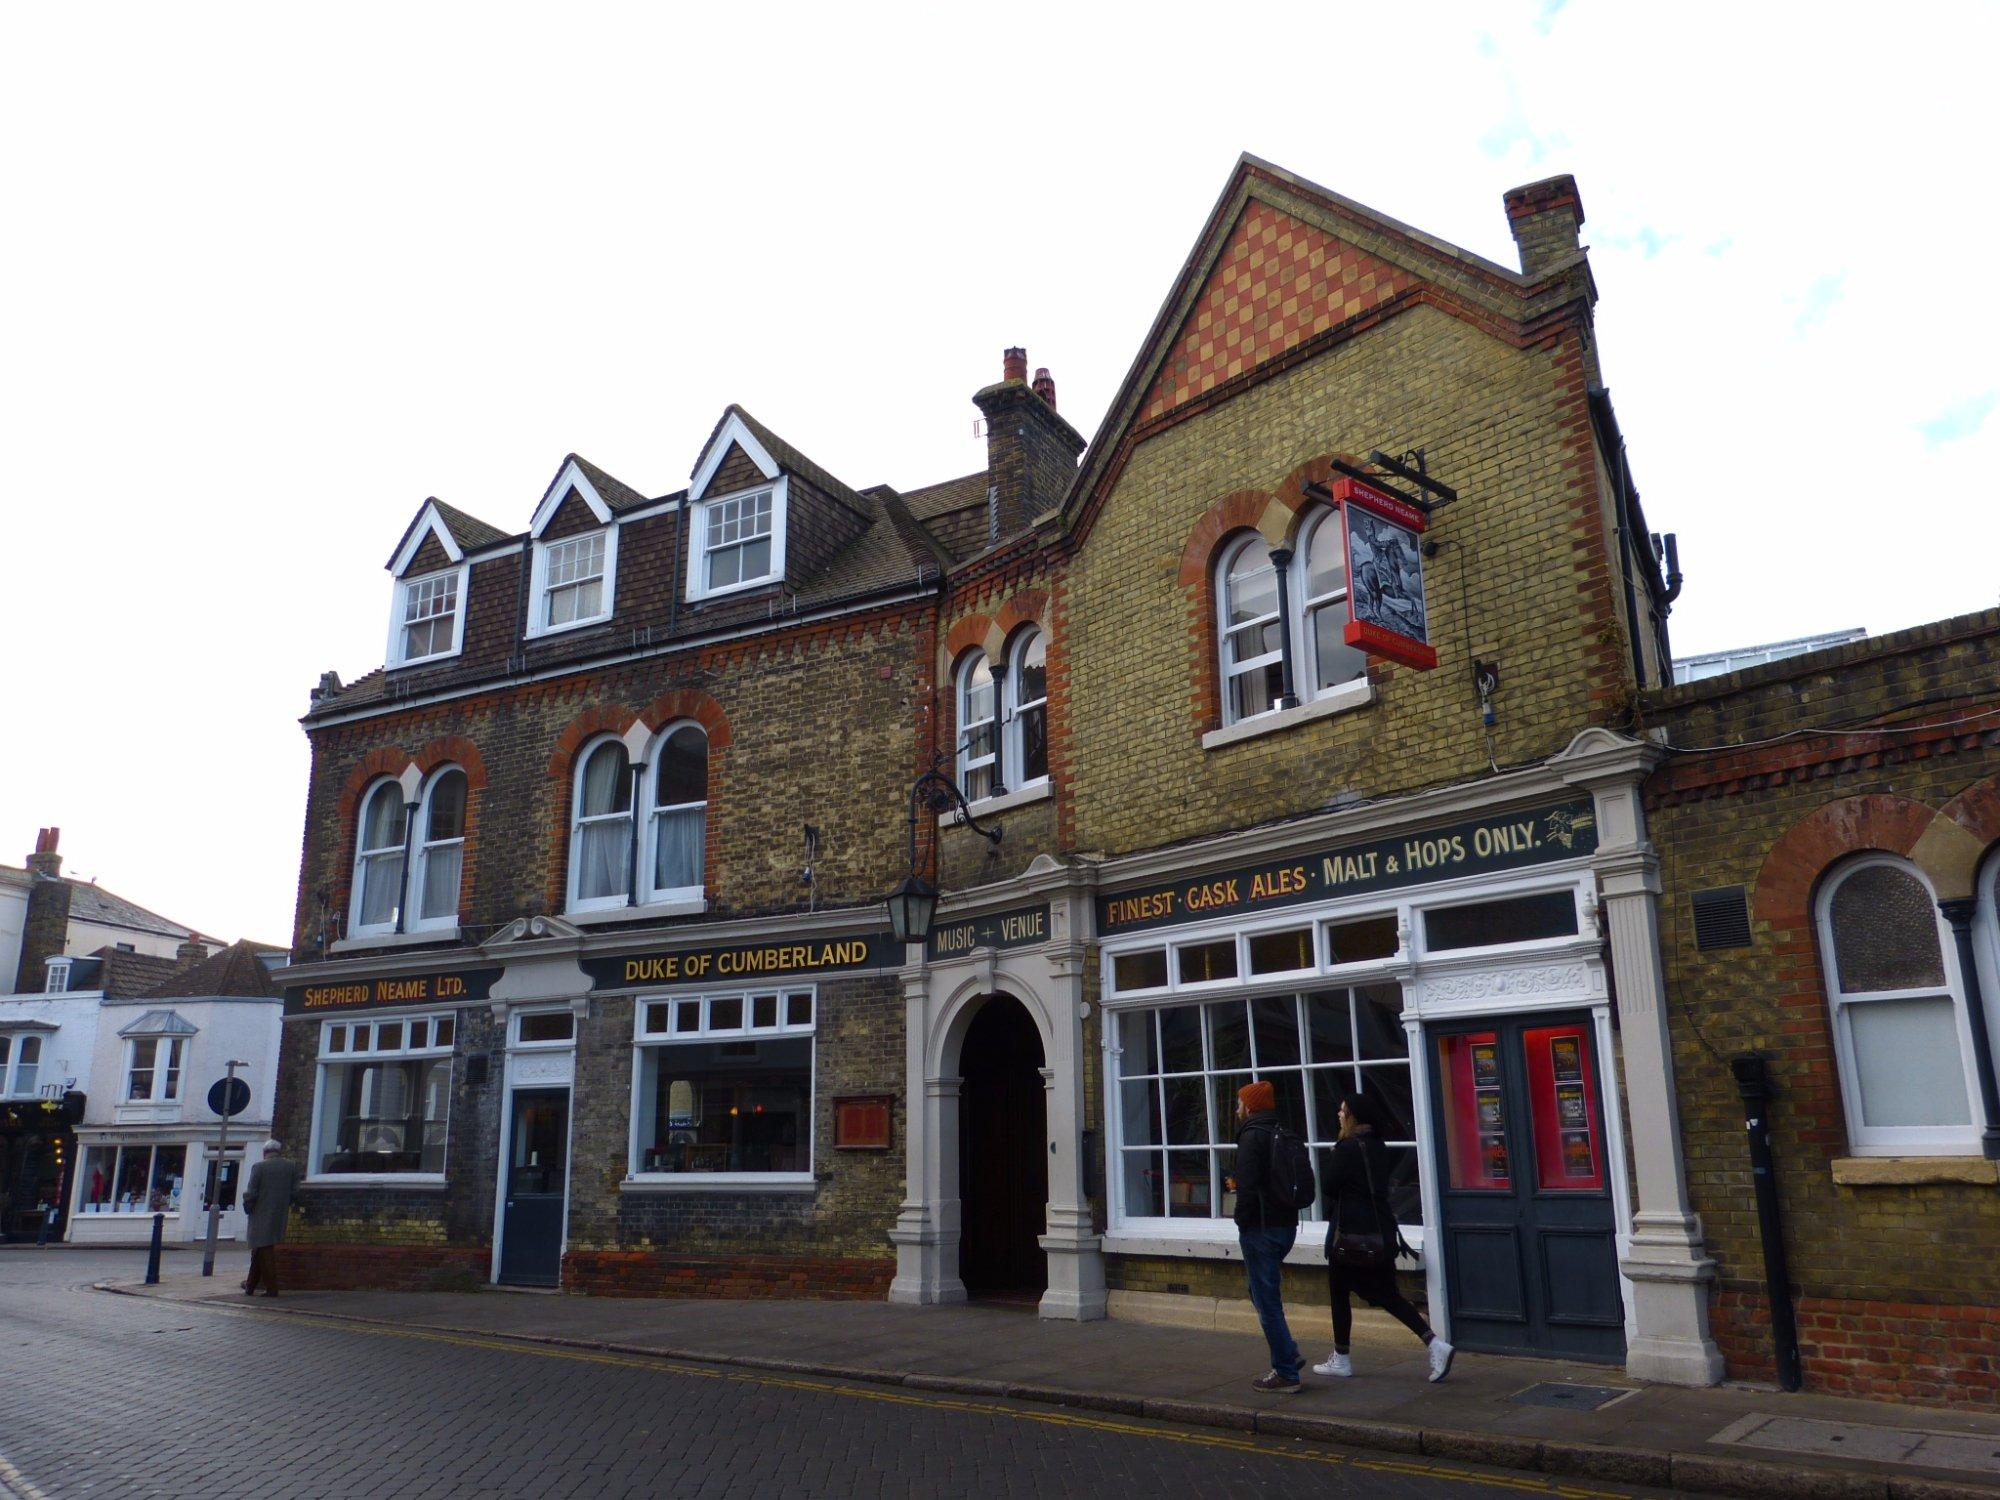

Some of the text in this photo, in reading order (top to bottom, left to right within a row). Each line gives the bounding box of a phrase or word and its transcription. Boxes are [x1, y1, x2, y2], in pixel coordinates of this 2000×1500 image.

[1353, 487, 1420, 522] SHEPHERD NEAME
[1107, 821, 1542, 925] FINEST CASK ALES MALT & HOPS ONLY.
[936, 925, 976, 953] MUSIC
[1001, 912, 1043, 941] VENUE
[625, 941, 868, 981] DUKE OF CUMBERLAND
[304, 985, 369, 1007] SHEPHERD
[376, 980, 428, 1001] NEAME
